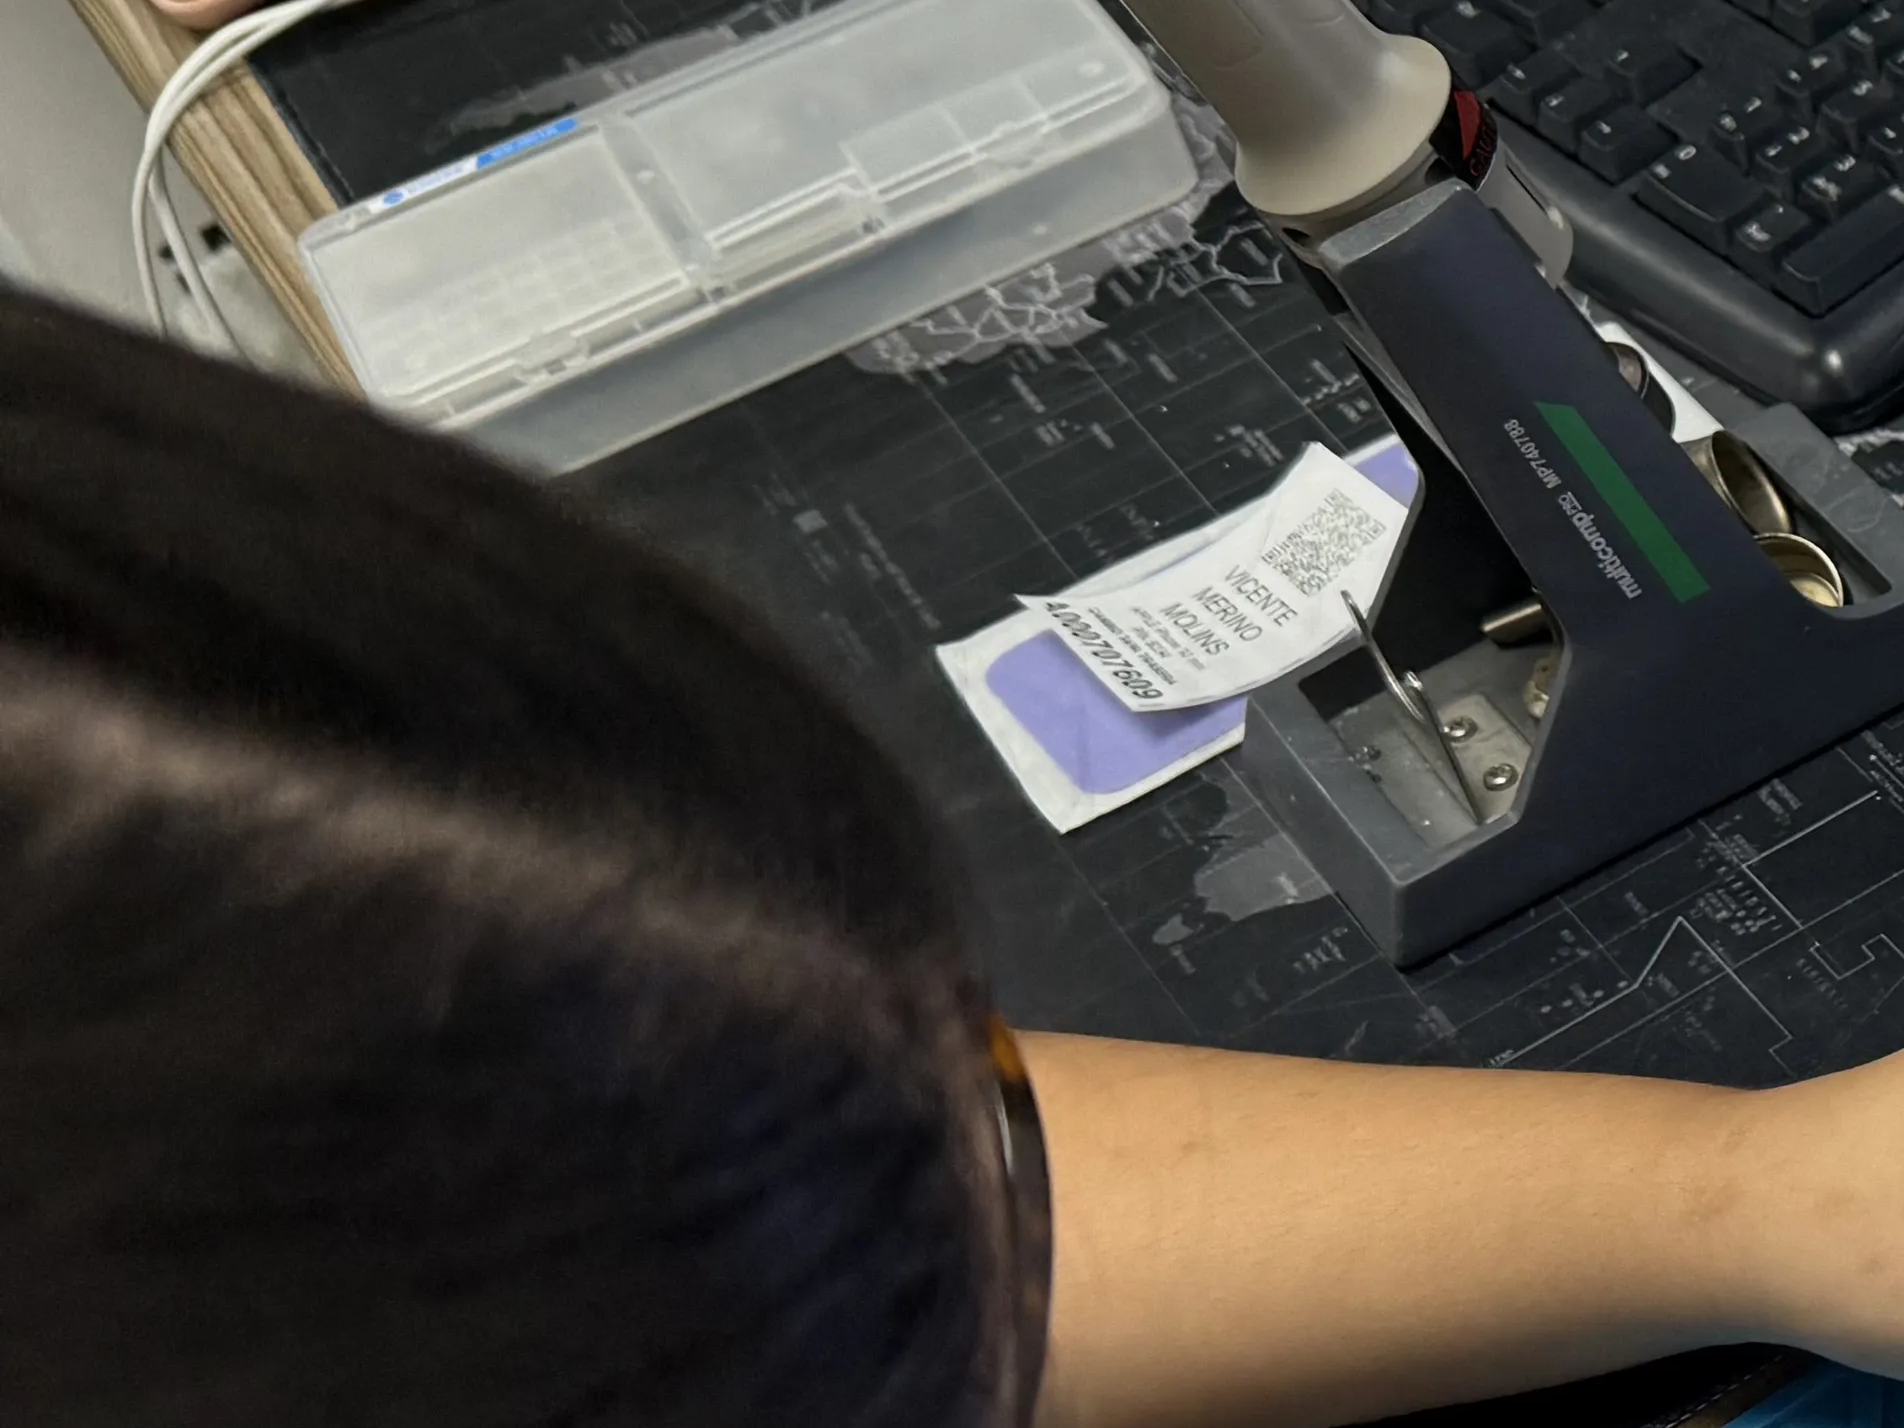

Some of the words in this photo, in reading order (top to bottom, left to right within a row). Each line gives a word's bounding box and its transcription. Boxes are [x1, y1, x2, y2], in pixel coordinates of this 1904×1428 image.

[1502, 417, 1563, 489] MP740788
[1567, 507, 1644, 600] multicomp
[1192, 586, 1265, 643] MERINO
[1225, 564, 1298, 628] VICENTE
[1160, 603, 1230, 657] MOLINS
